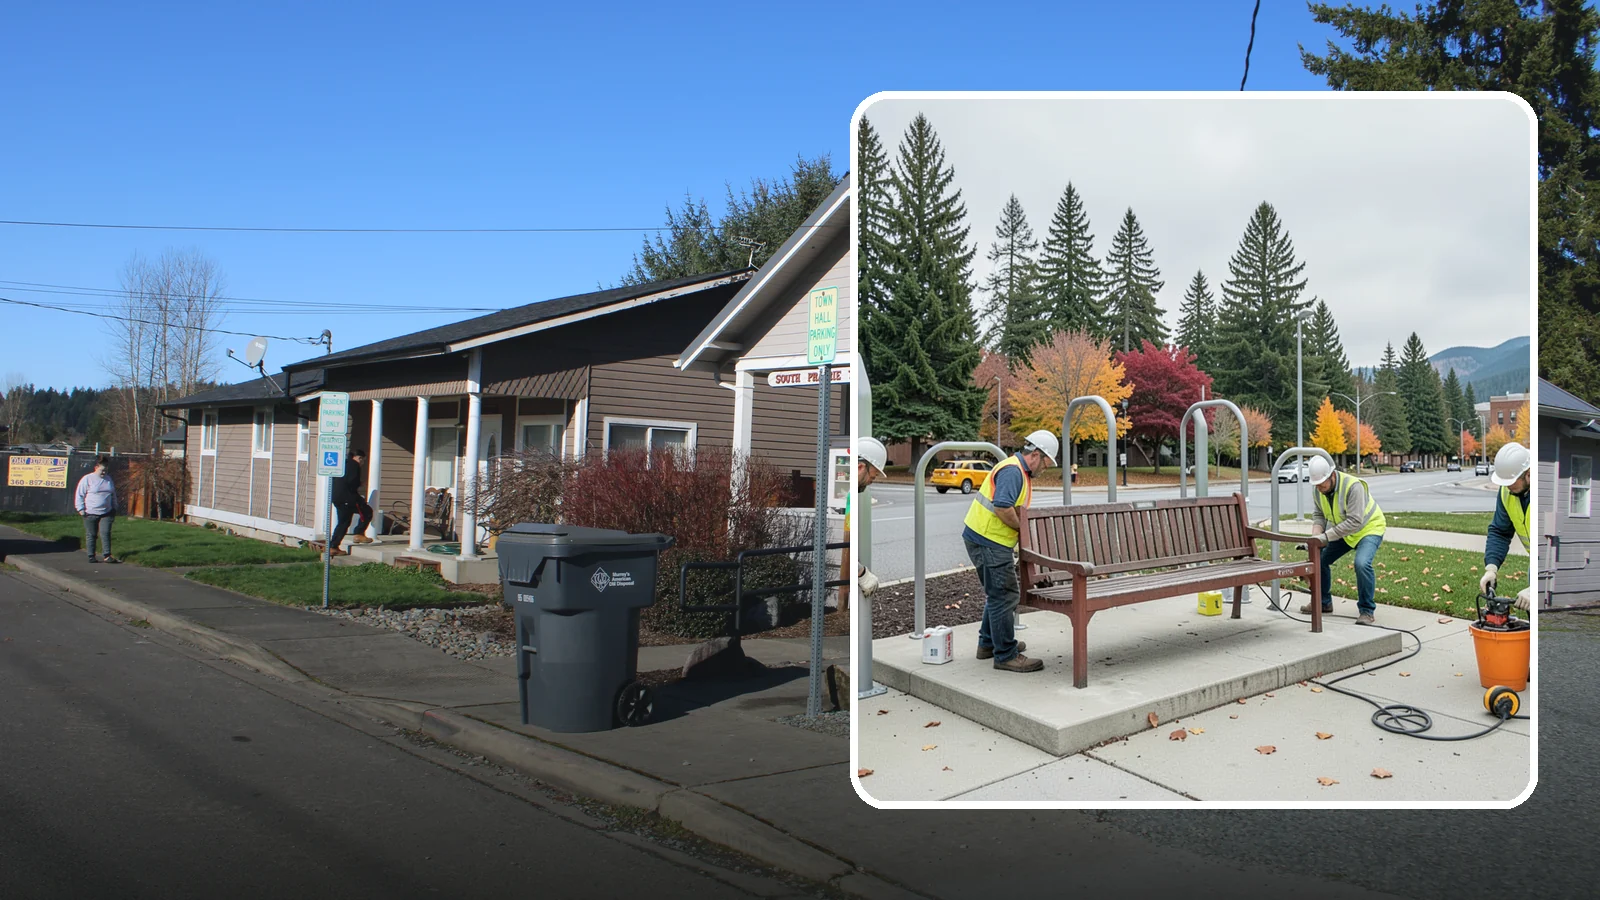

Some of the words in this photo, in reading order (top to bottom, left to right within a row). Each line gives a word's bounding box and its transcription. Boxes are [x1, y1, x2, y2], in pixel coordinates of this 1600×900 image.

[815, 294, 833, 308] TOWN
[814, 311, 831, 324] HALL
[810, 326, 836, 340] PARKING
[813, 344, 831, 357] ONLY
[775, 373, 801, 384] SOUTH
[808, 371, 841, 382] PRIE
